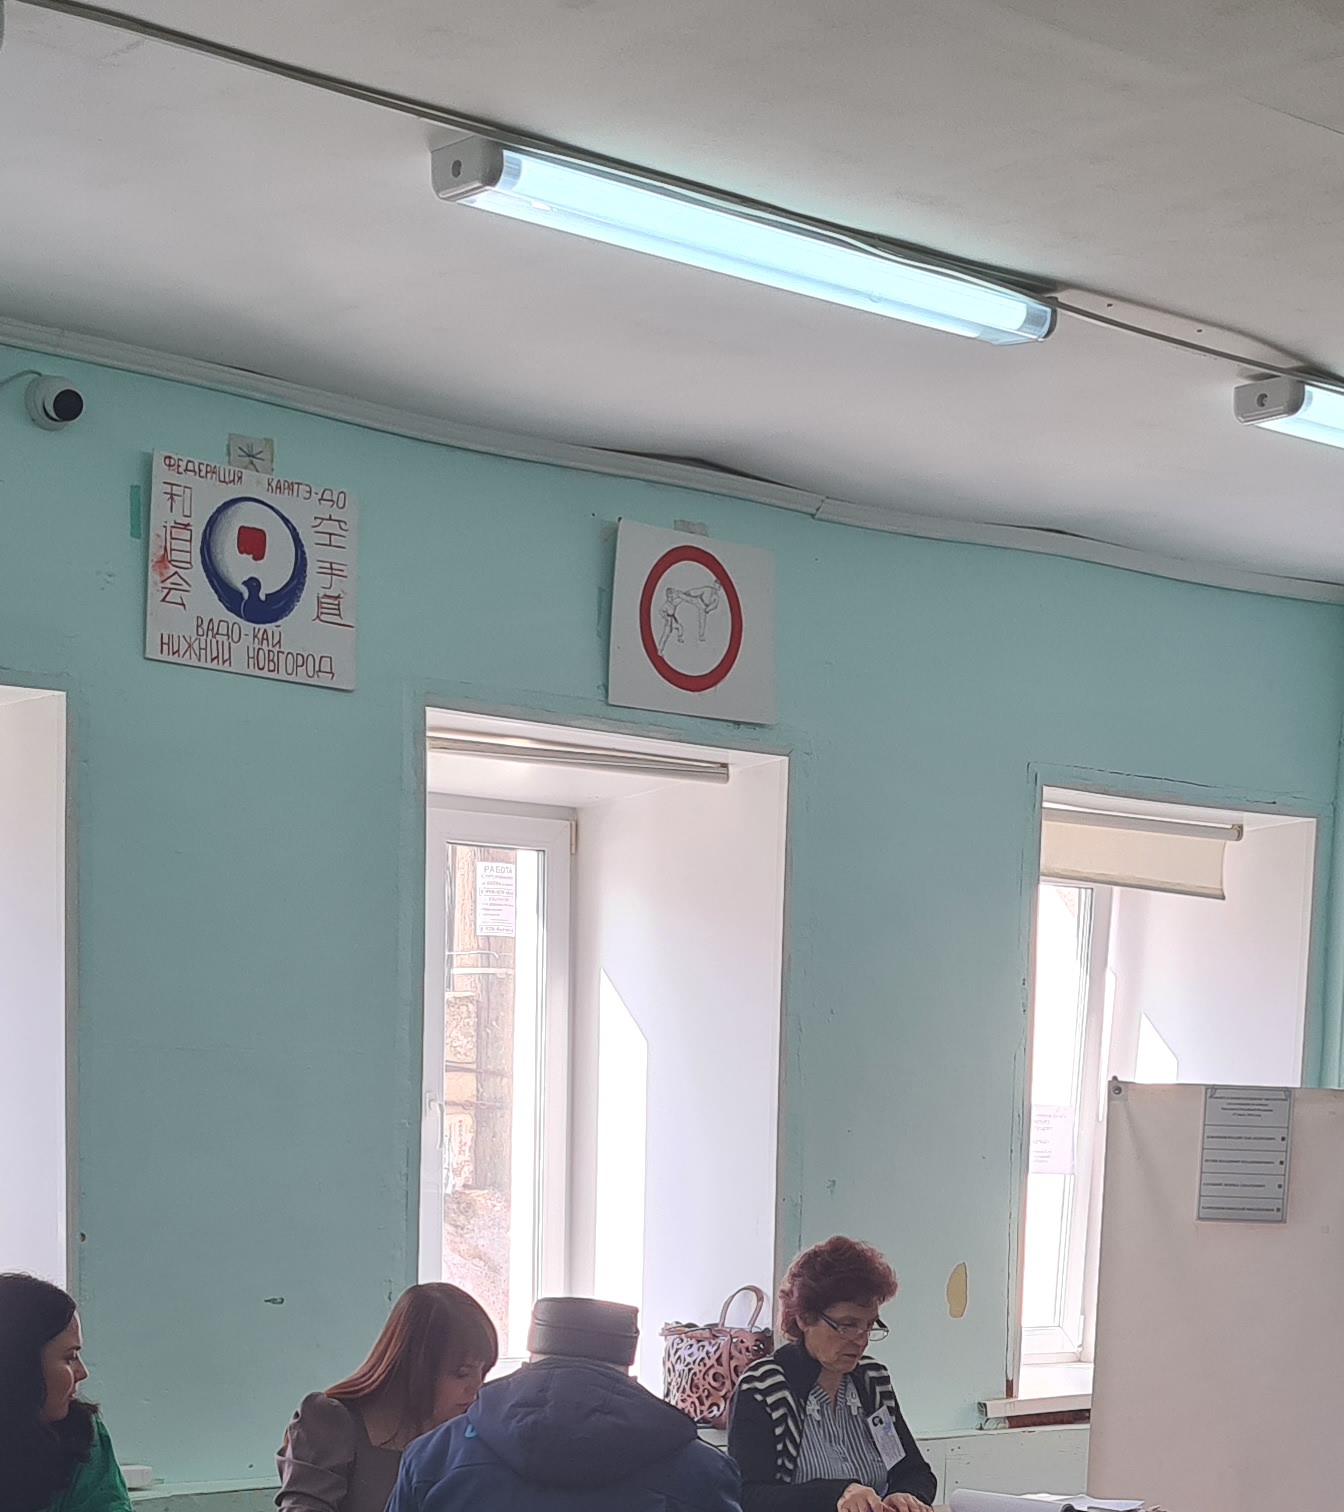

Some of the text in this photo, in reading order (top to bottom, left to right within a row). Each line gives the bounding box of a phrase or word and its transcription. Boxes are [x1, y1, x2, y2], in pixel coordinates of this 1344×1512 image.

[163, 455, 243, 486] ФЕДЕРАЦИЯ
[196, 615, 282, 649] ВАДО-КАЙ
[247, 645, 335, 681] НОВГОРОД
